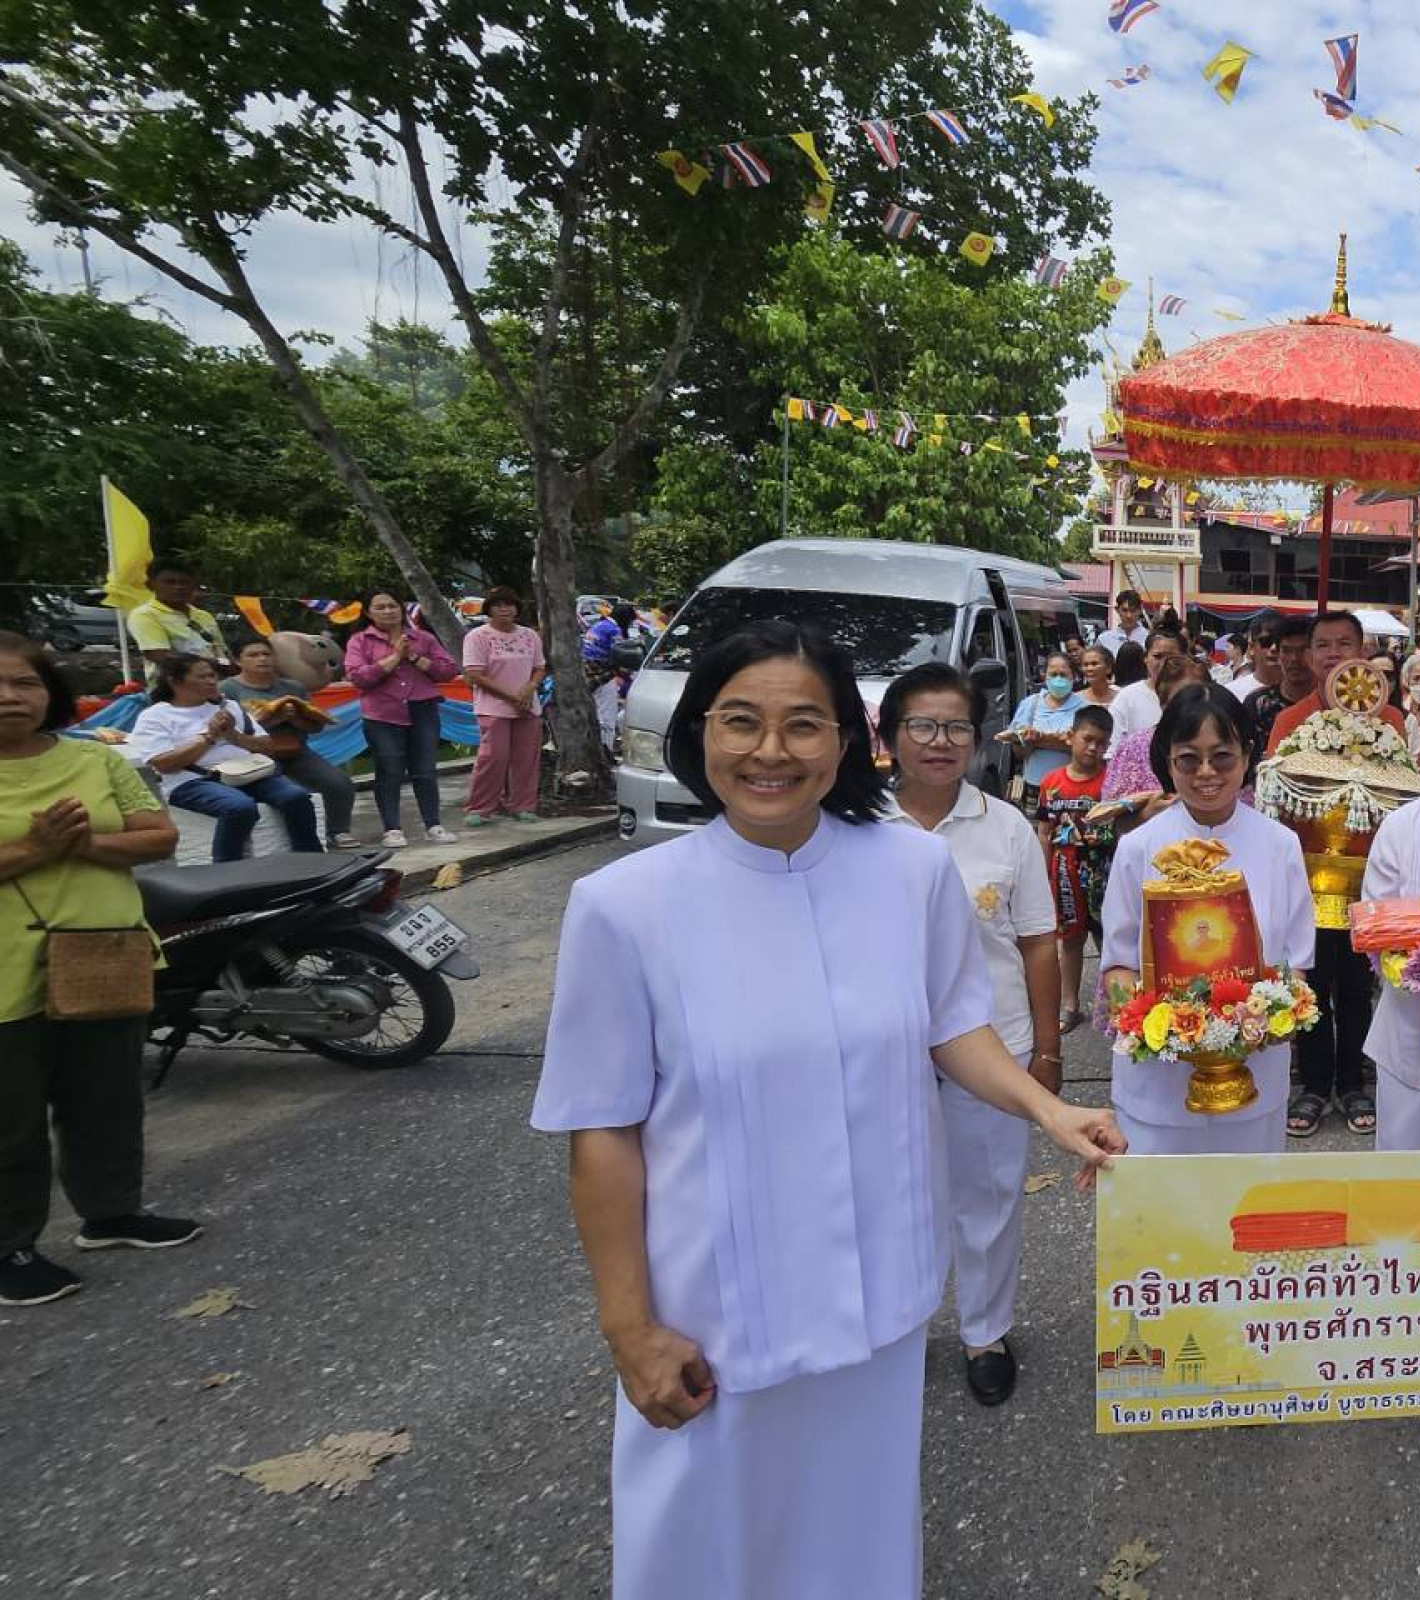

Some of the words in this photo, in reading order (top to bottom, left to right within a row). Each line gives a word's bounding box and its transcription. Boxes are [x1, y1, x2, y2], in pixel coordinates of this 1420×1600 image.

[426, 933, 456, 958] 855
[1111, 1403, 1152, 1424] โดย
[1160, 1392, 1330, 1421] คณะศิษยานุศิษย์
